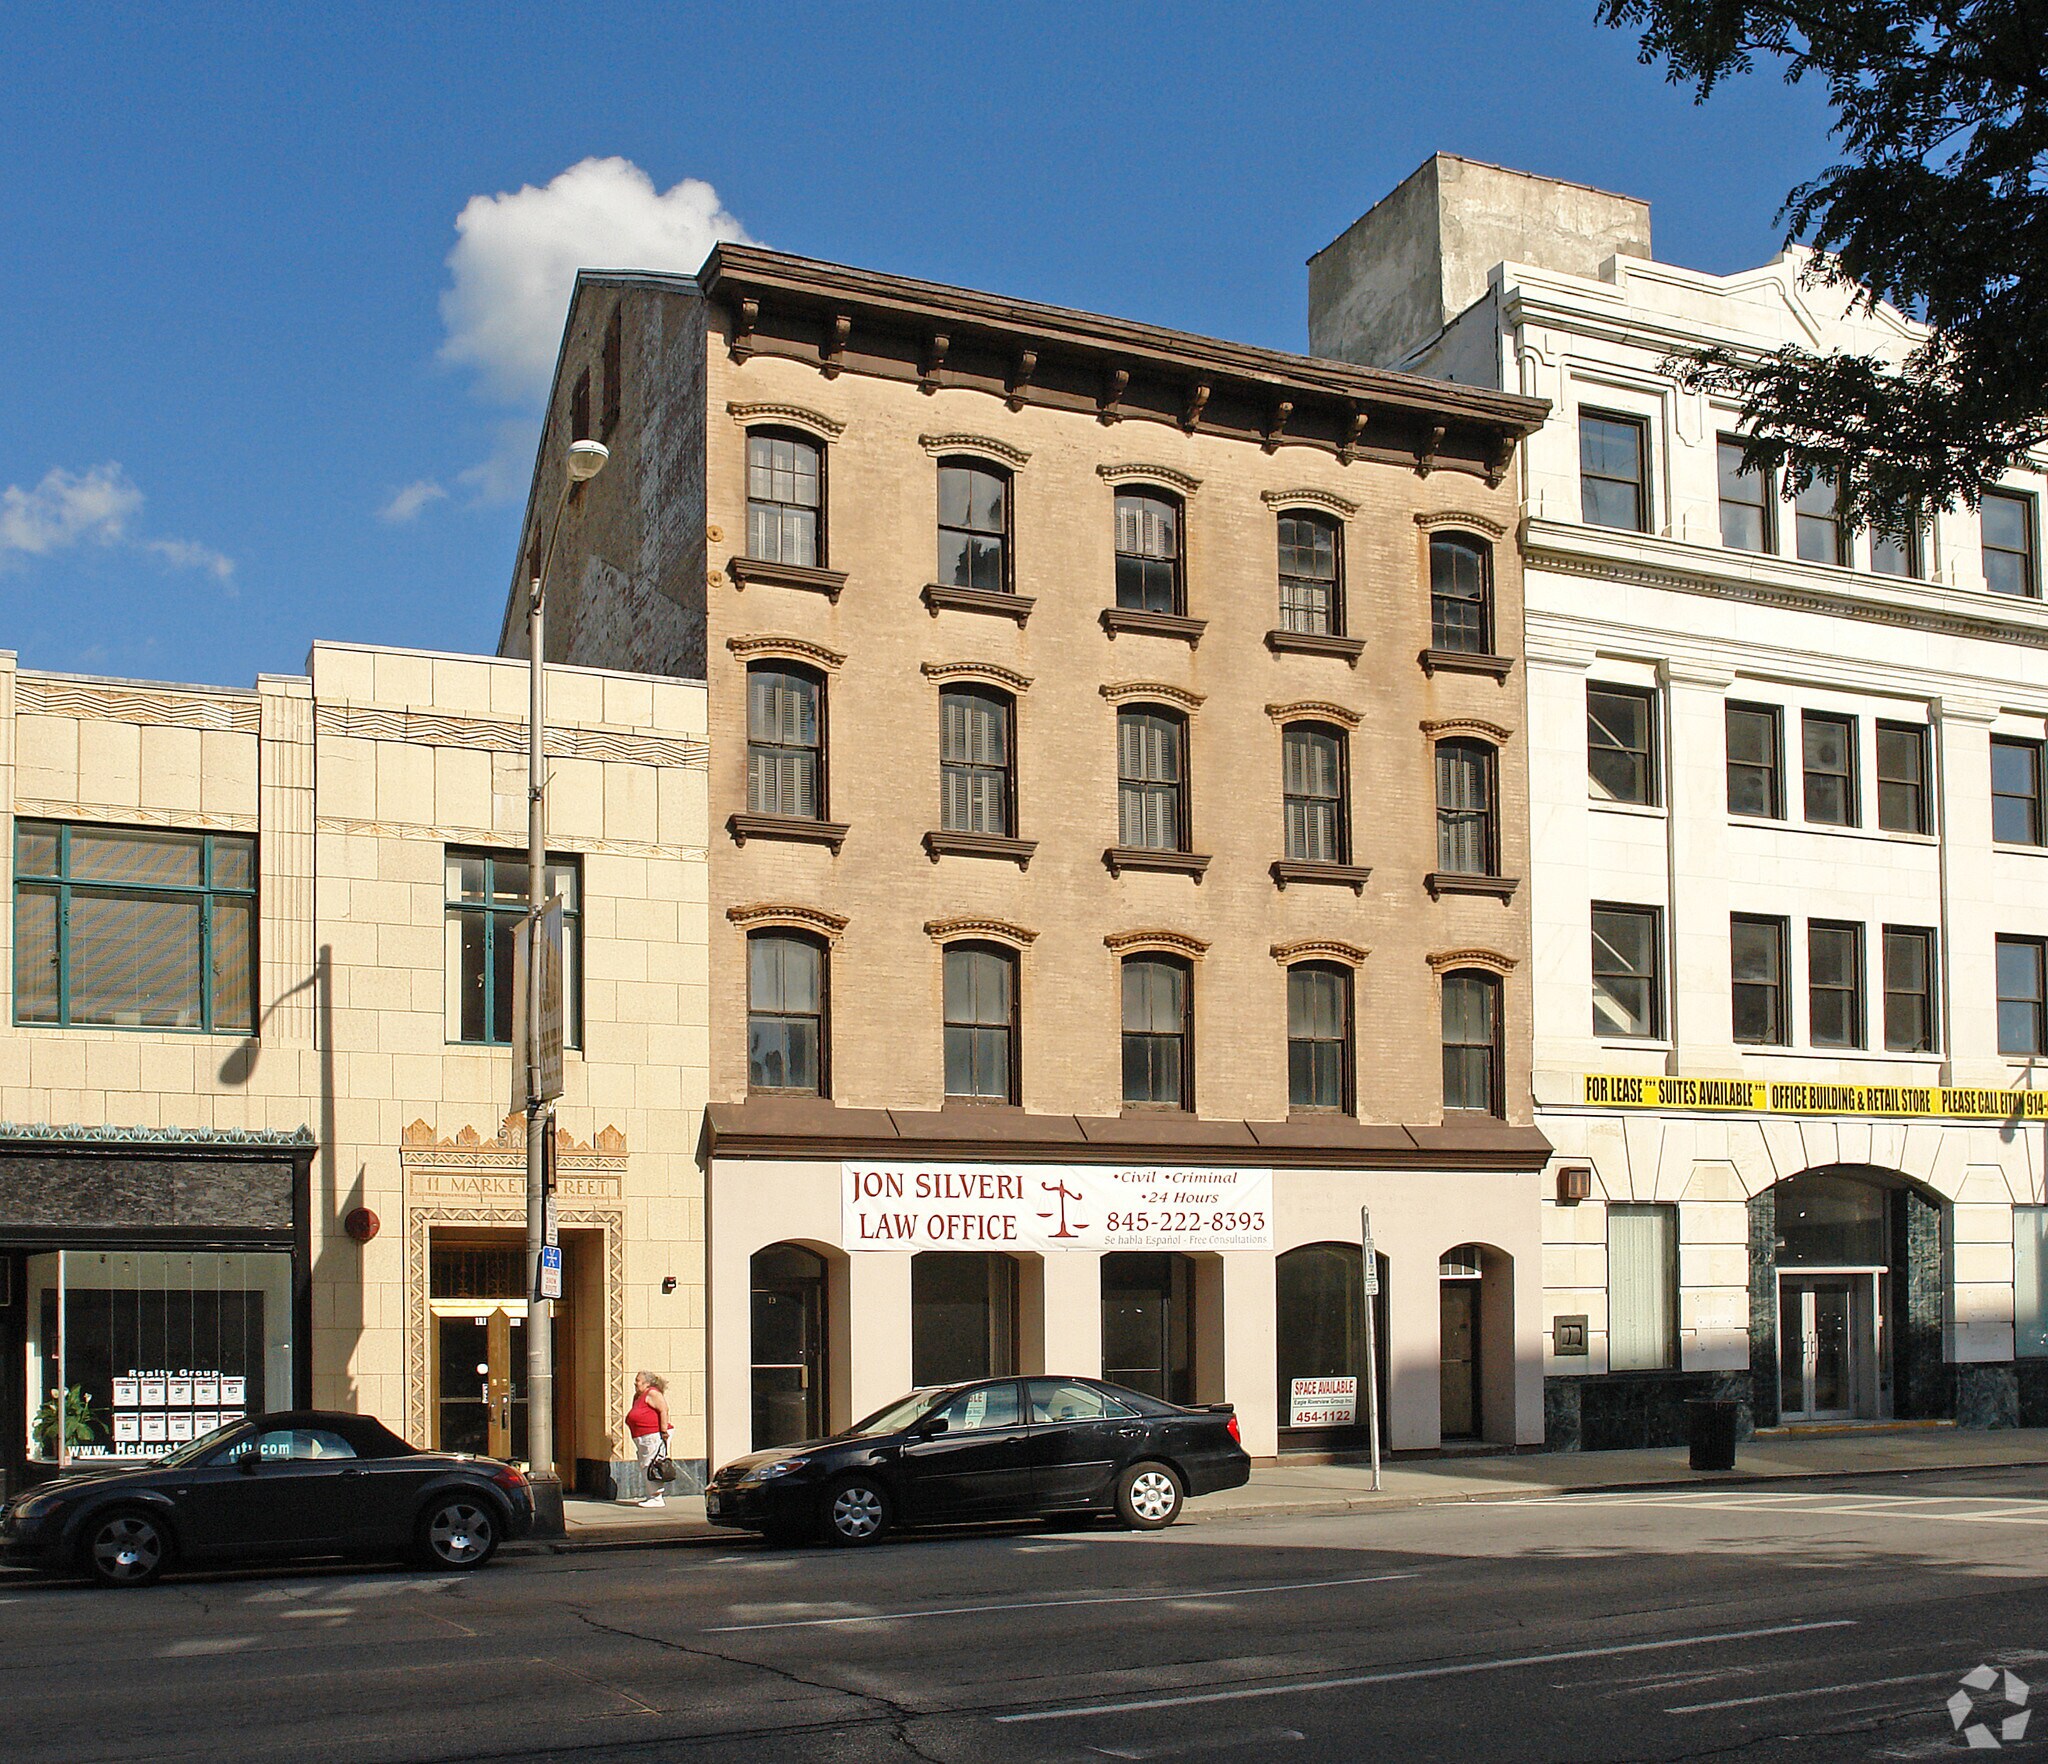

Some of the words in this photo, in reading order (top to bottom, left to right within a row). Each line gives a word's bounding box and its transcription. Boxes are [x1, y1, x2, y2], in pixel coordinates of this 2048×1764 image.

[1586, 1077, 1608, 1101] FOR
[1611, 1077, 1643, 1103] LEASE
[1658, 1080, 1696, 1105] SUITES
[1699, 1081, 1753, 1106] AVAILABLE
[1772, 1085, 1807, 1109] OFFICE
[1809, 1086, 1855, 1110] BUILDING
[1857, 1091, 1865, 1111] &
[1867, 1088, 1900, 1112] RETAIL
[1901, 1089, 1930, 1113] STORE
[1941, 1090, 1976, 1114] PLEASE
[1978, 1091, 1999, 1114] CALL
[2000, 1092, 2025, 1115] EITAN
[427, 1177, 440, 1191] 11
[555, 1179, 608, 1195] TREET
[1172, 1171, 1238, 1184] Criminal
[852, 1172, 904, 1203] JON
[915, 1173, 1024, 1199] SILVERI
[1173, 1192, 1219, 1204] Hours
[859, 1213, 918, 1239] LAW
[927, 1214, 1018, 1240] OFFICE
[1106, 1211, 1265, 1232] 845-222-8393
[1104, 1235, 1116, 1245] Se
[1118, 1235, 1143, 1245] habla
[1146, 1235, 1181, 1247] Español
[1189, 1235, 1207, 1245] Free
[1209, 1234, 1267, 1245] Consultations
[1295, 1381, 1317, 1395] SPACE
[1318, 1380, 1354, 1395] AVAILABLE
[1296, 1410, 1351, 1423] 454-1122
